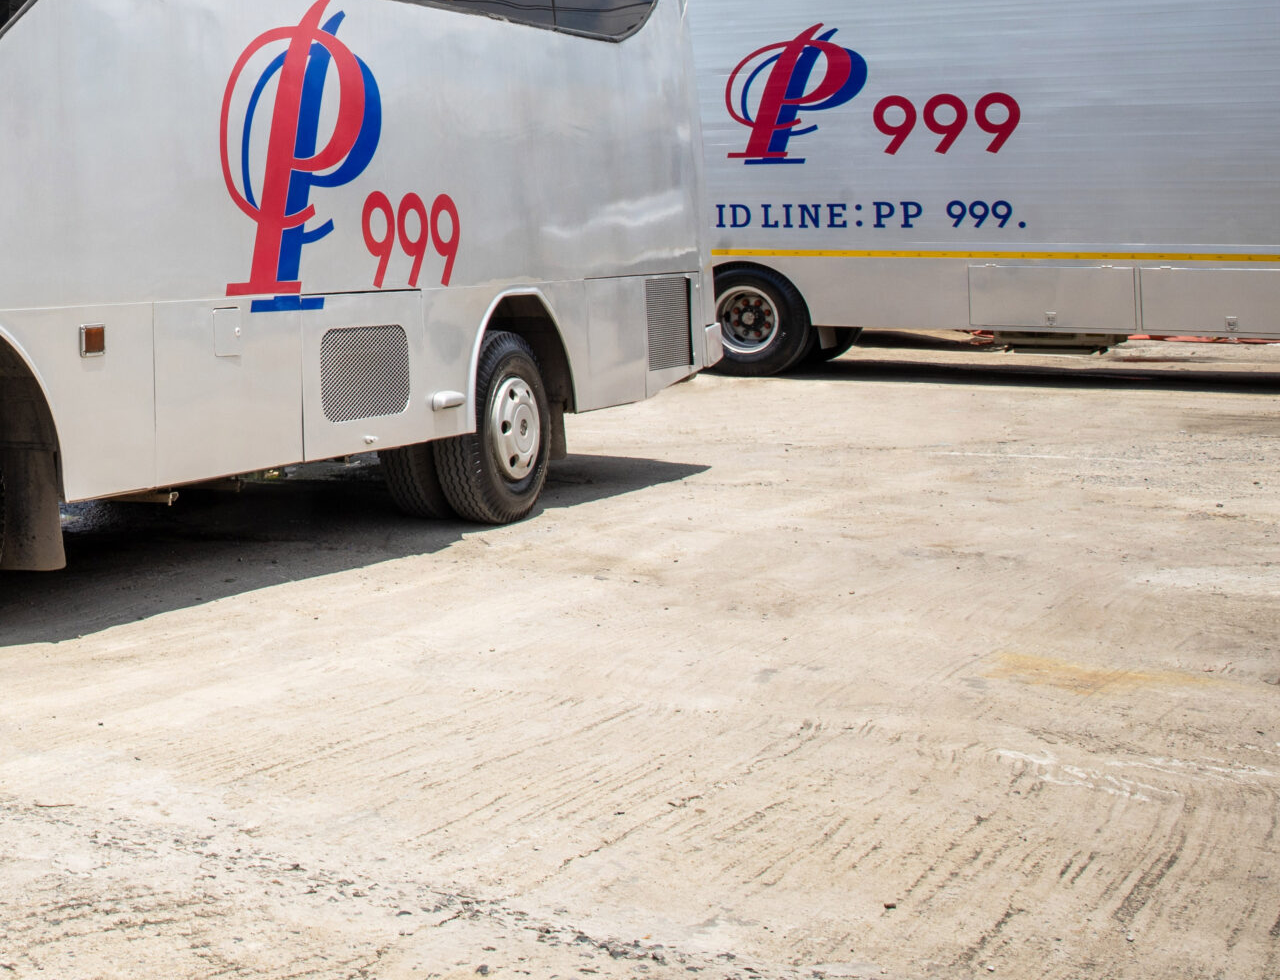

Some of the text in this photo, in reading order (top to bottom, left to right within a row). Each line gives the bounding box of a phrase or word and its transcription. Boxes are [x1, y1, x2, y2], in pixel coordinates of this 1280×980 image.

[873, 92, 1021, 155] 999
[362, 191, 461, 289] 999
[716, 204, 752, 229] ID
[873, 201, 924, 229] PP
[946, 200, 1027, 229] 999.
